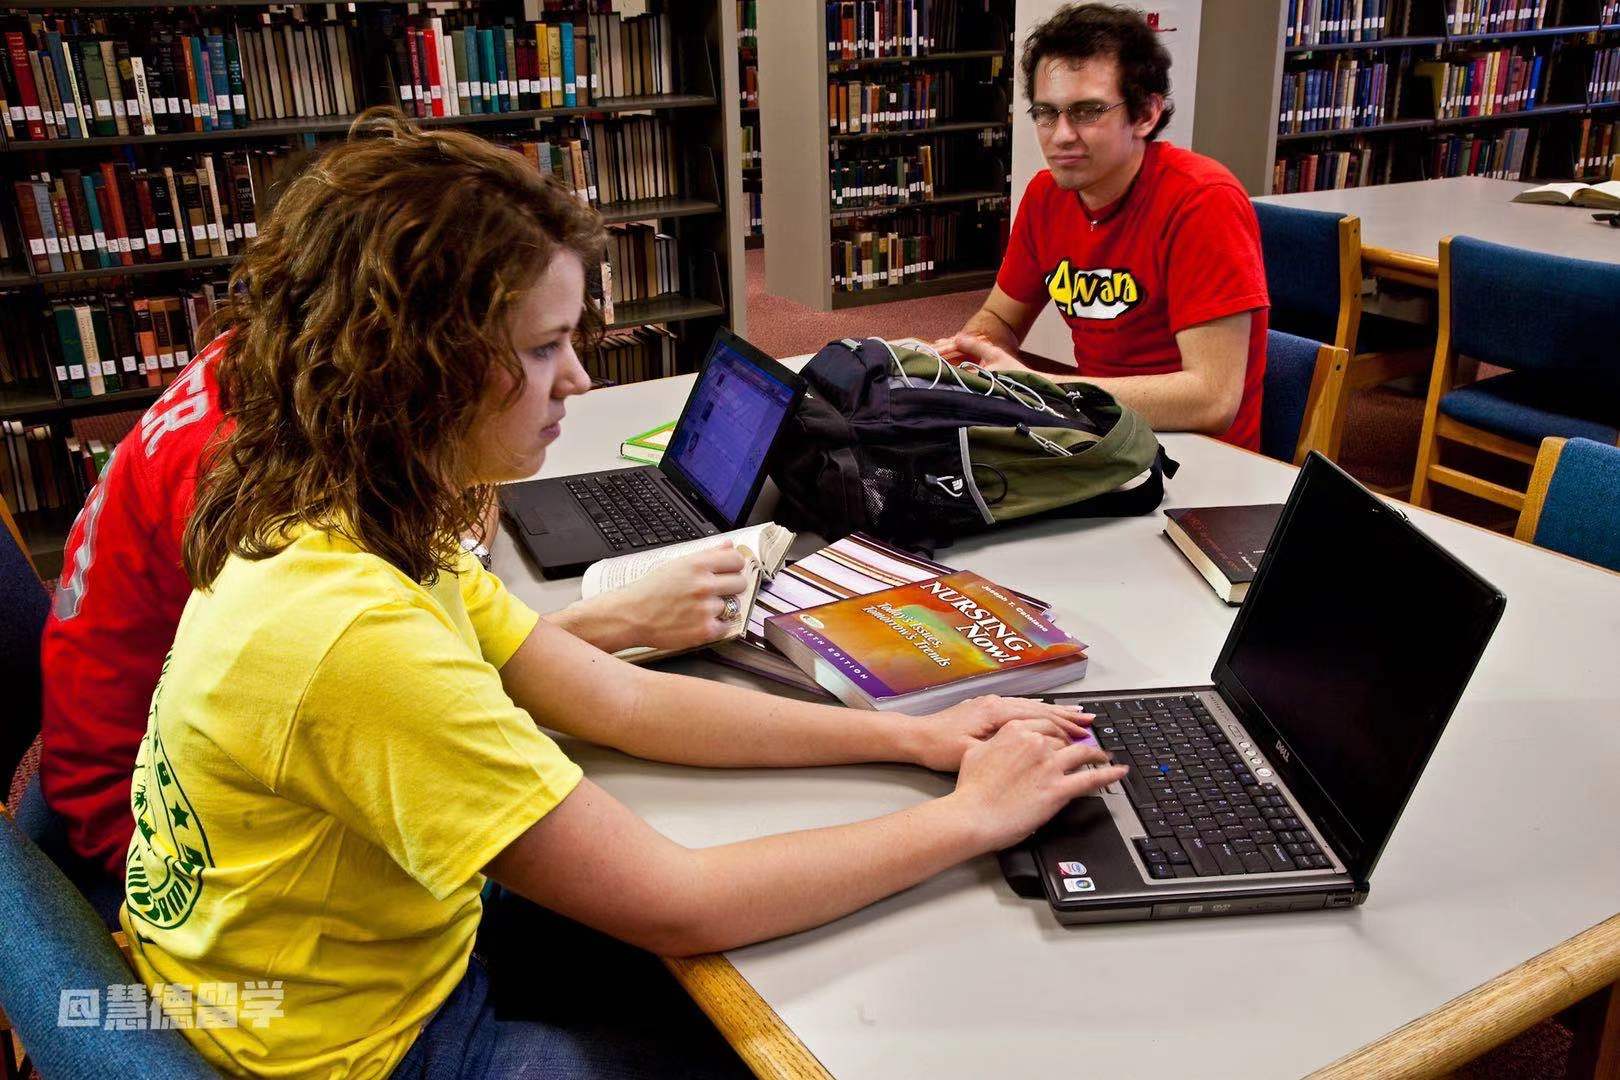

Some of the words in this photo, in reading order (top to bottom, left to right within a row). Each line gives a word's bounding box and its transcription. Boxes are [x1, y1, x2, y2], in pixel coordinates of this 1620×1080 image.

[862, 605, 918, 641] Tomorrow's
[913, 640, 951, 668] Trends
[876, 601, 914, 624] Today's
[920, 580, 1033, 652] NURSING
[798, 627, 825, 646] FIFTH
[827, 647, 869, 680] EDITION
